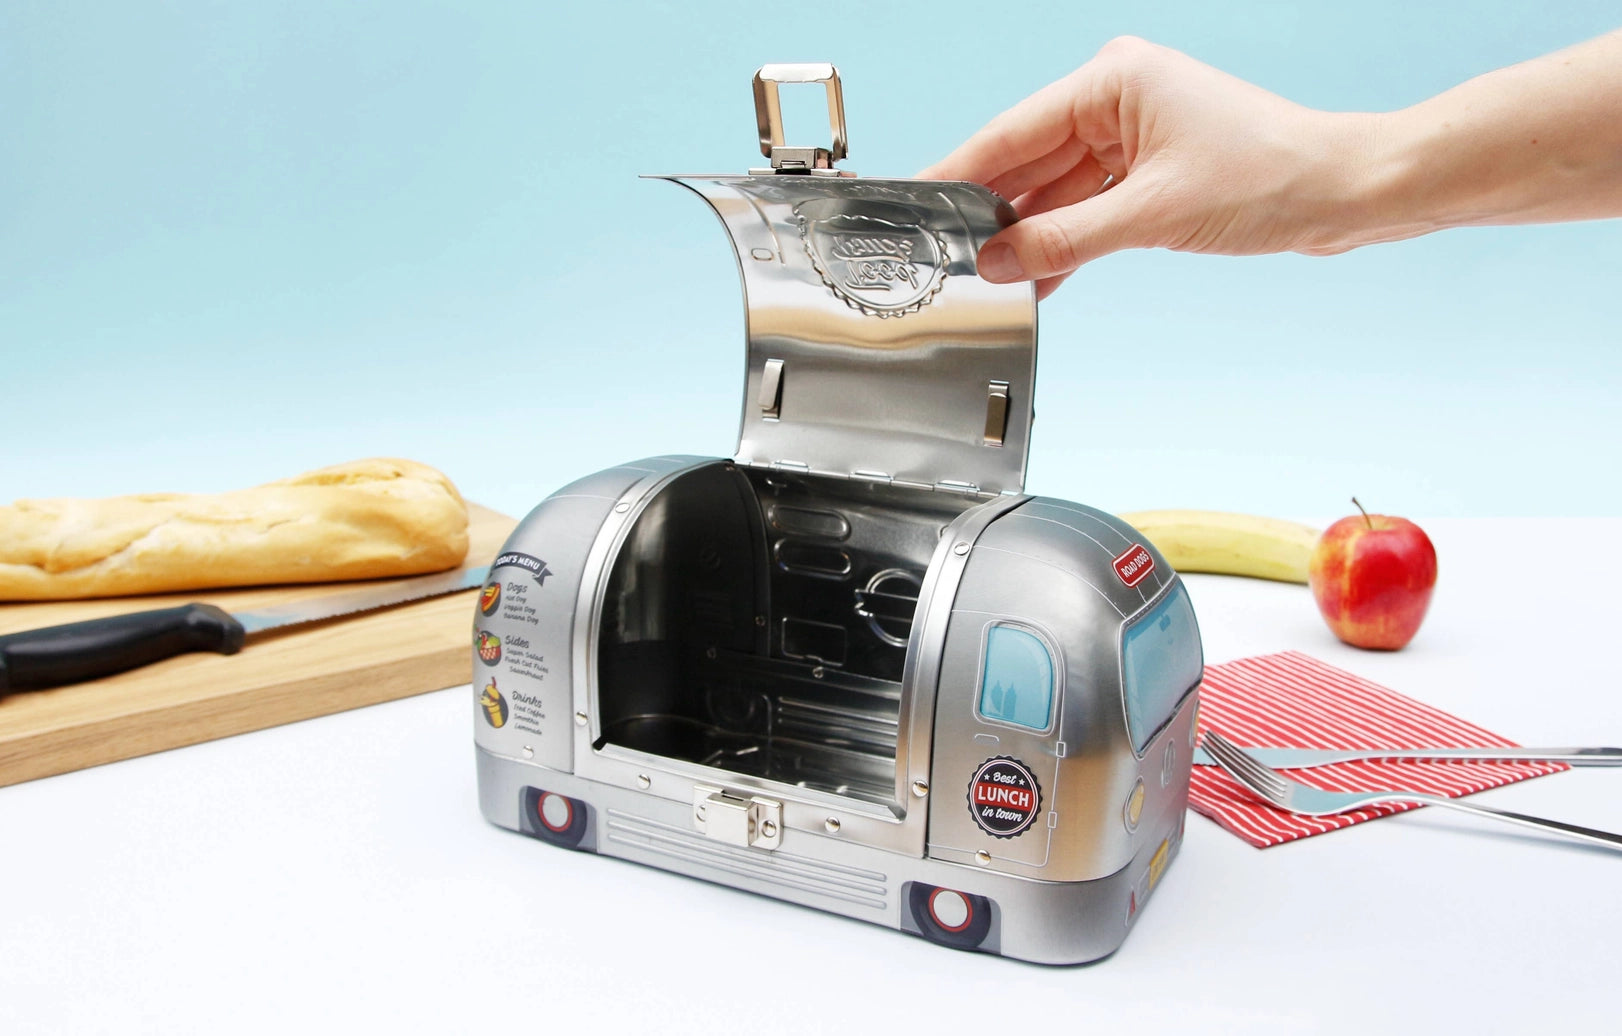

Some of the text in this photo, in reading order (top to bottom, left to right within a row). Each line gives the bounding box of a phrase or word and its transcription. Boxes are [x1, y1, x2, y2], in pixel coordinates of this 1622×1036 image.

[517, 557, 540, 570] MENU
[1121, 550, 1149, 578] ROAD DOGS
[506, 582, 528, 594] Dogs
[505, 635, 529, 648] Sides
[512, 690, 542, 708] Drinks
[993, 771, 1017, 784] Best
[978, 785, 1029, 807] LUNCH
[981, 806, 1023, 822] in town
